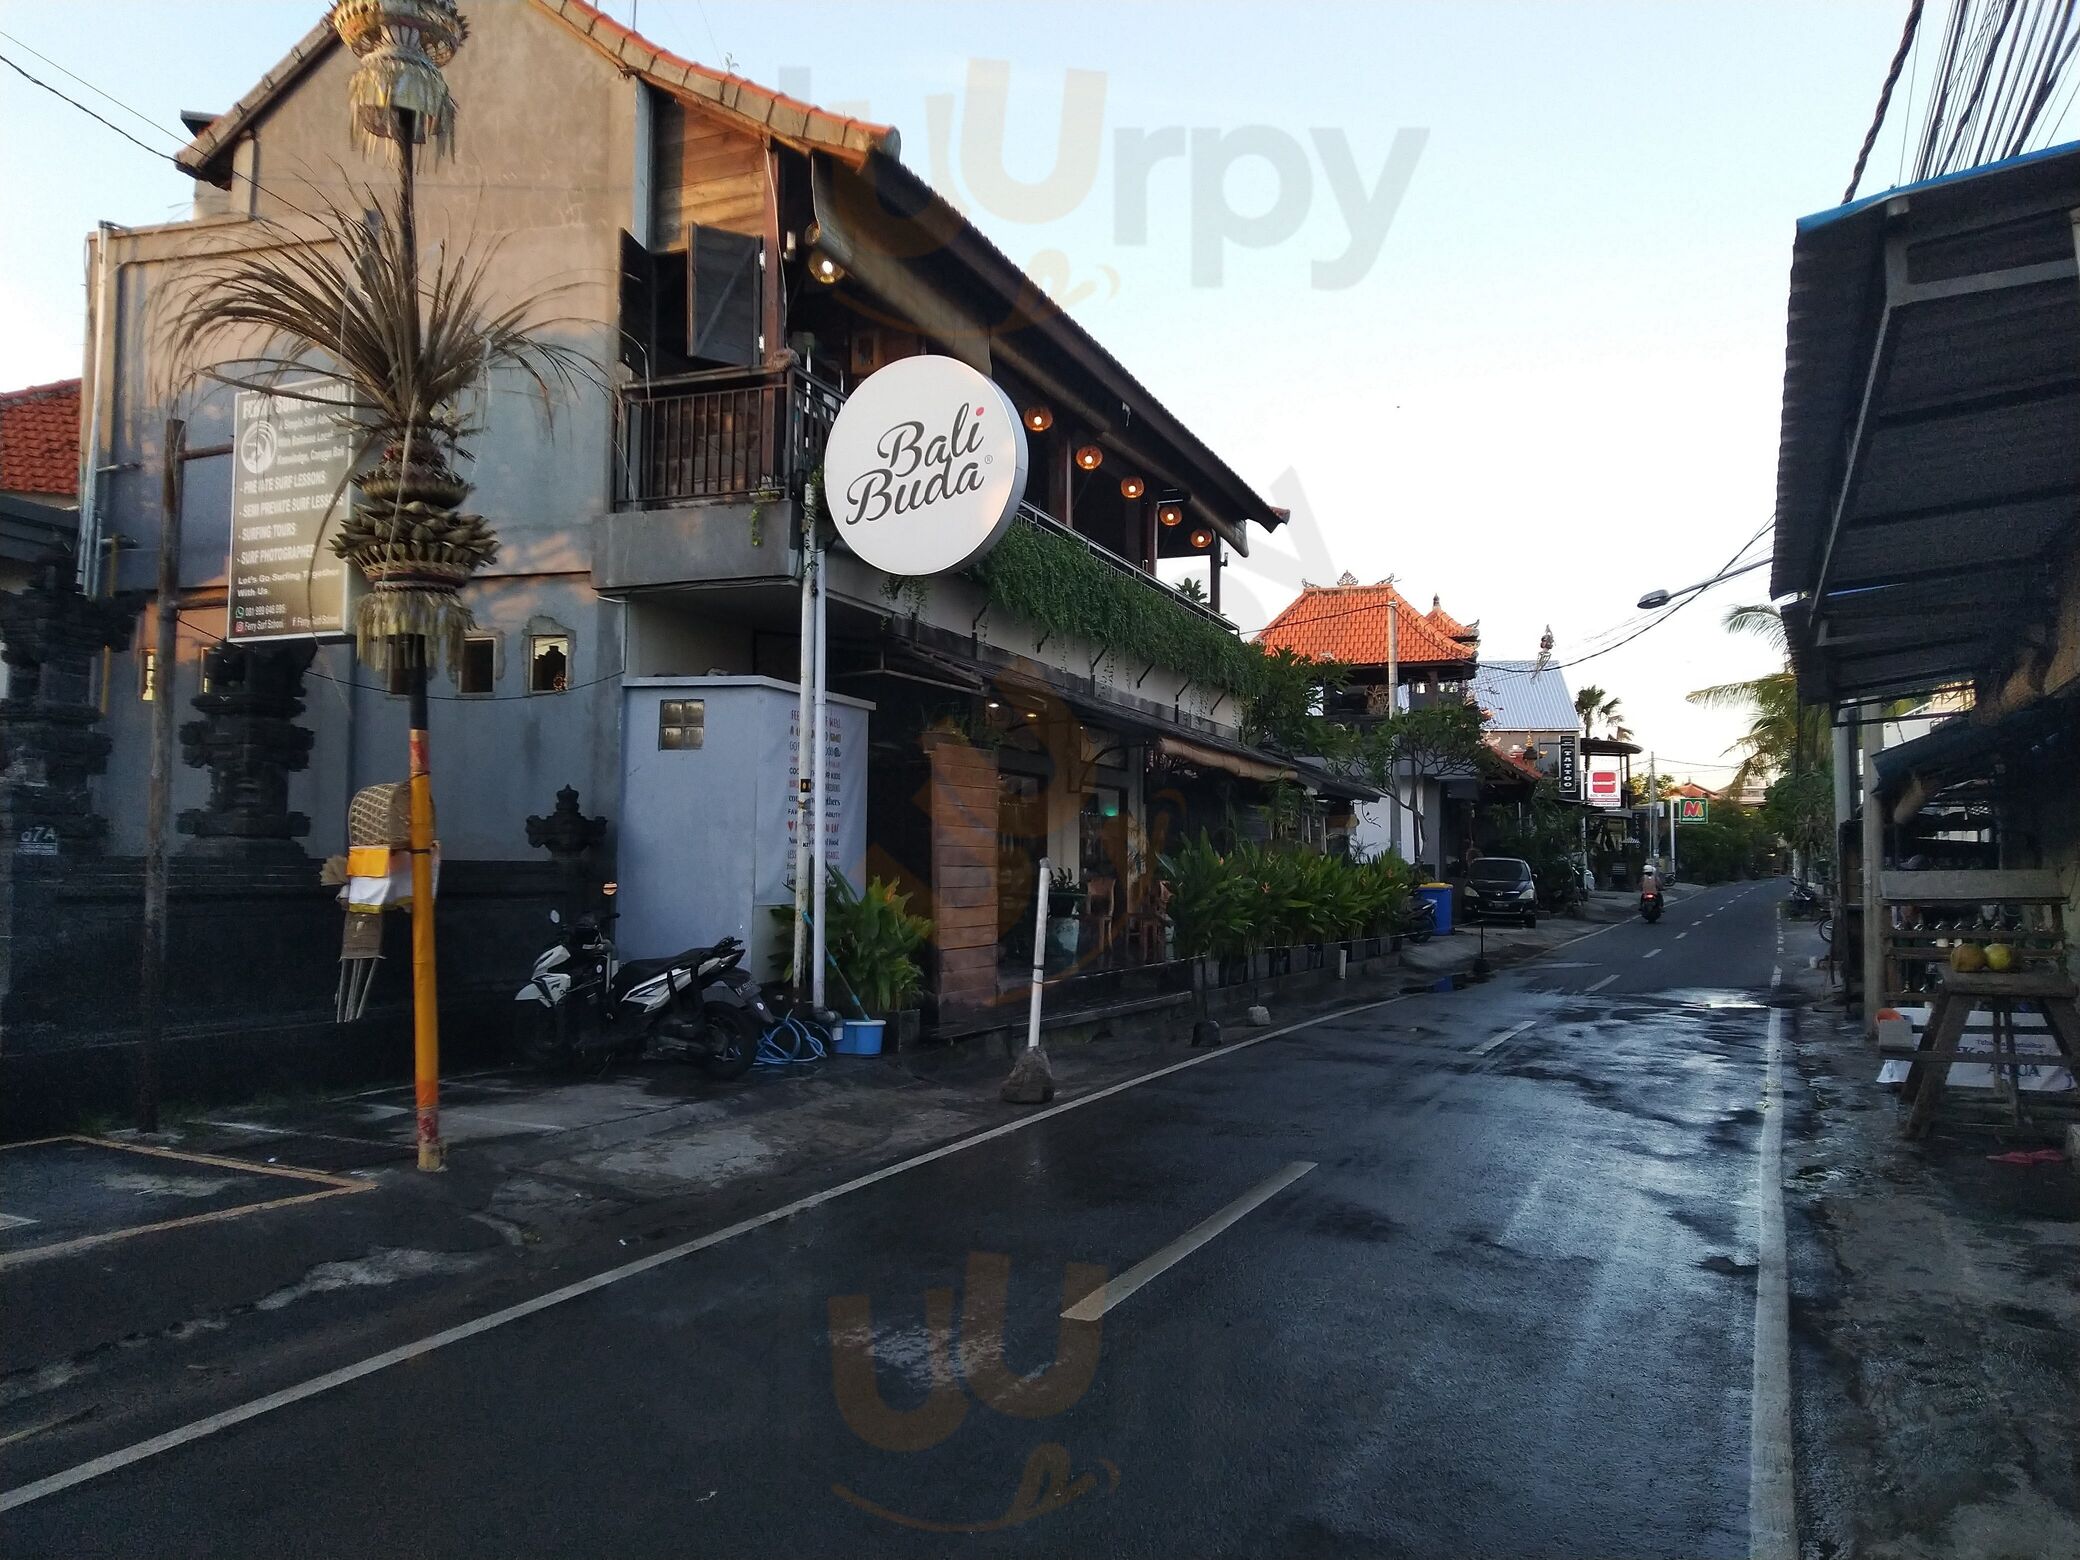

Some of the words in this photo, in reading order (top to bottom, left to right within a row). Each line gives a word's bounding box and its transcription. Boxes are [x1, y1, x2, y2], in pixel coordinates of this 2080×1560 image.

[877, 402, 985, 478] Bali
[846, 456, 985, 526] Buda
[302, 568, 340, 579] Tgether
[1563, 750, 1573, 788] TATTOO
